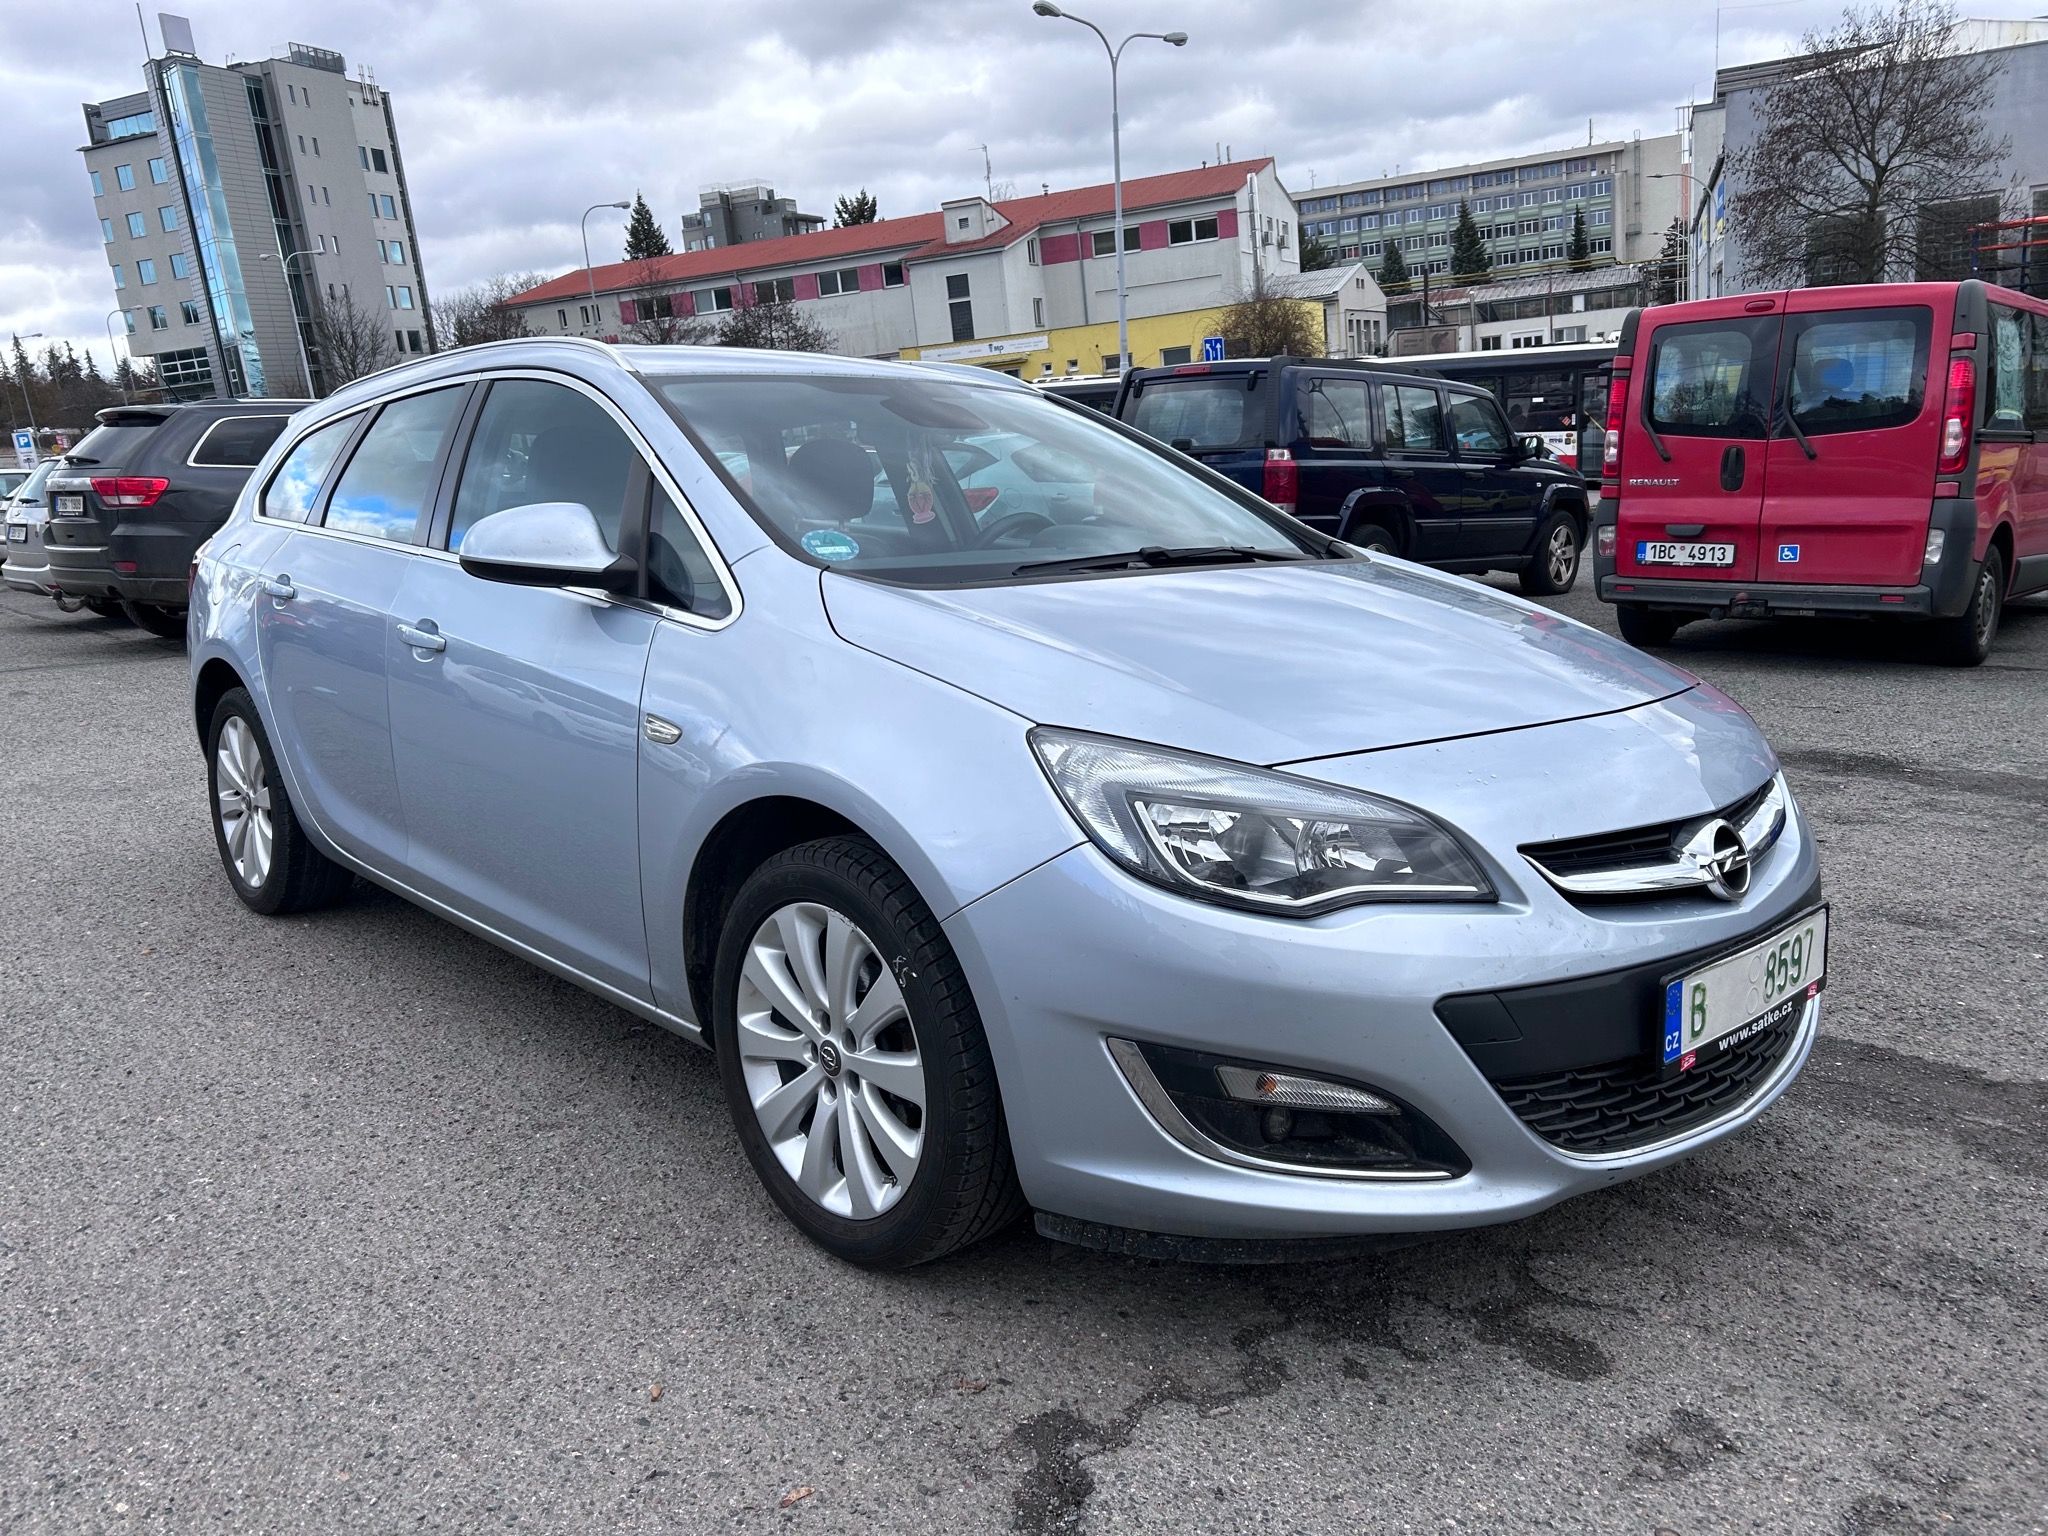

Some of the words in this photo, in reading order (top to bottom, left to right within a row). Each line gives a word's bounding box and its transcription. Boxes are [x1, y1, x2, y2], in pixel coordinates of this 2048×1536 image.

[19, 436, 28, 446] P
[1628, 478, 1680, 487] RENAULT
[1650, 544, 1677, 560] 1BC
[1687, 545, 1727, 562] 4913
[1690, 981, 1707, 1041] B
[1763, 927, 1814, 1002] 8597
[1718, 1001, 1793, 1052] www.satke.cz
[1665, 1031, 1679, 1052] CZ
